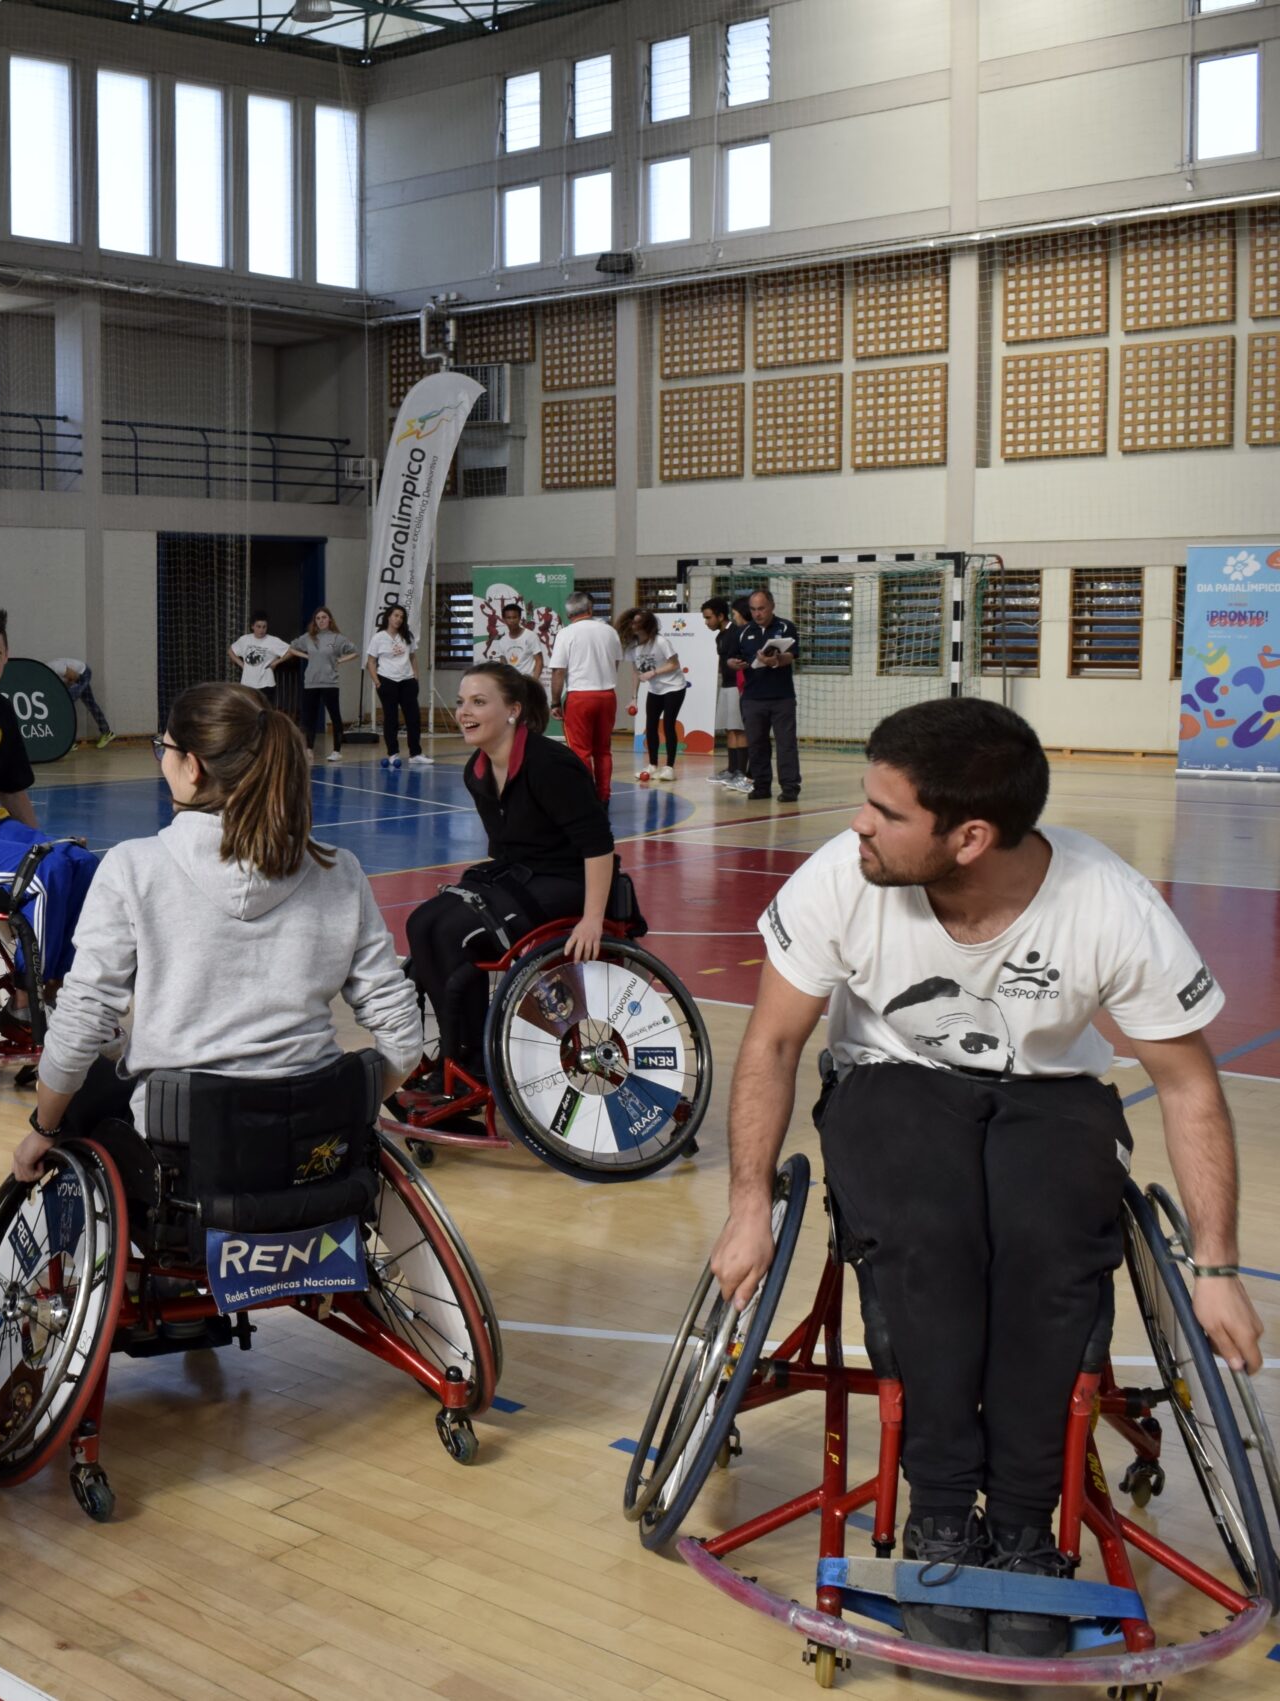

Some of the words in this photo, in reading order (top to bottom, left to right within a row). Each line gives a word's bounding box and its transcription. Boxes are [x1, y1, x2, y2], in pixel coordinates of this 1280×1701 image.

[381, 447, 426, 585] Paralímpico
[1196, 583, 1214, 592] DIA
[11, 691, 49, 720] OS
[21, 724, 54, 738] CASA
[997, 984, 1060, 1000] DESPORTO
[648, 1056, 674, 1066] REN
[628, 1105, 663, 1136] BRAGA
[220, 1236, 317, 1279] REN
[225, 1291, 249, 1304] Redes
[303, 1276, 356, 1287] Nacionais
